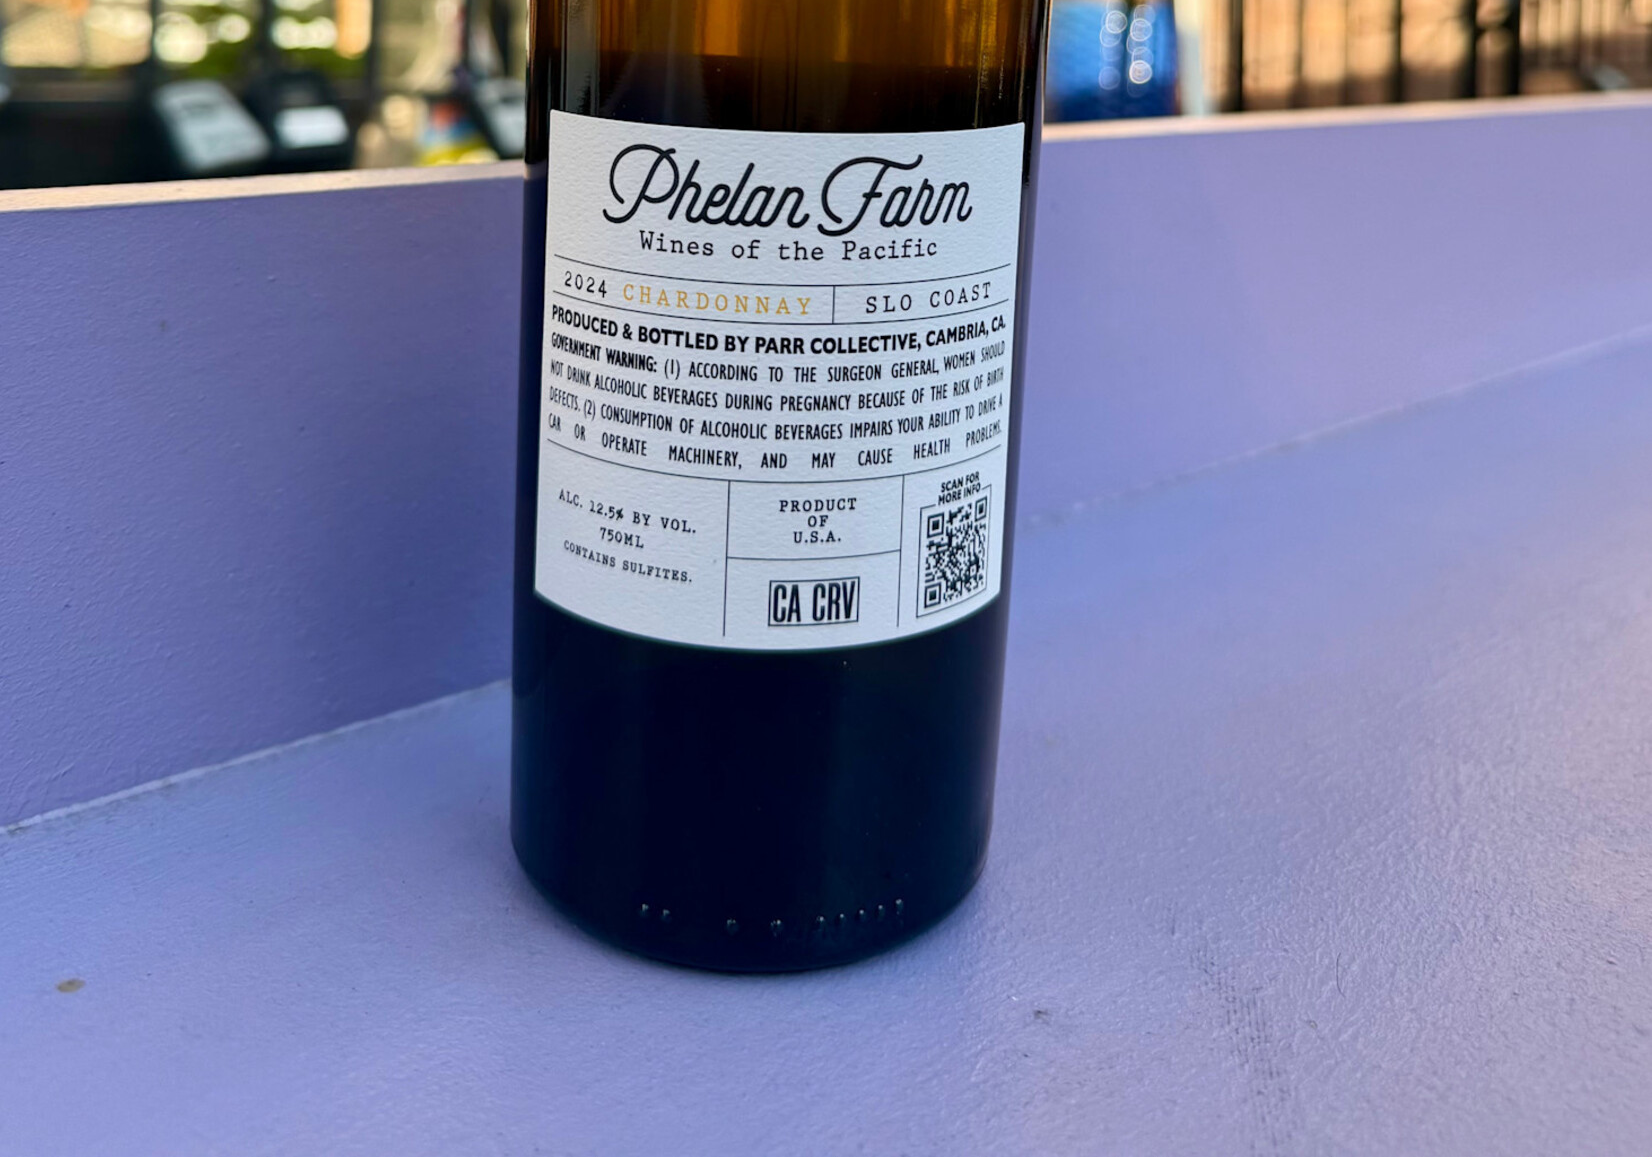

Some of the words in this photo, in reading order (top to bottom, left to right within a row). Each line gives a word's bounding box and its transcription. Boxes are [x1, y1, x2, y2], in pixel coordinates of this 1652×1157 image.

[602, 144, 810, 229] Phelan
[817, 154, 972, 237] Farm
[639, 230, 714, 257] Wines
[731, 241, 760, 259] of
[778, 241, 824, 261] the
[843, 239, 938, 261] Pacific
[564, 271, 607, 297] 2024
[623, 284, 811, 315] CHARDONNAY
[866, 294, 912, 313] SLO
[930, 282, 991, 308] COAST
[552, 304, 618, 336] PRODUCED
[623, 324, 632, 340] &
[638, 326, 718, 350] BOTTLED
[725, 336, 749, 352] BY
[755, 337, 804, 354] PARR
[810, 333, 921, 354] COLLECTIVE,
[926, 321, 988, 347] CAMBRIA,
[992, 315, 1006, 331] CA.
[552, 332, 601, 361] GOVERNMENT
[606, 348, 657, 372] WARNING:
[689, 363, 757, 381] ACCORDING
[769, 367, 783, 382] TO
[794, 367, 816, 382] THE
[827, 365, 881, 382] SURGEON
[892, 358, 939, 378] GENERAL,
[944, 350, 975, 371] WOMEN
[981, 341, 1005, 363] SHOULD
[551, 359, 563, 375] NOT
[567, 367, 591, 386] DRINK
[595, 374, 647, 399] ALCOHOLIC
[654, 386, 717, 408] BEVERAGES
[726, 395, 772, 411] DURING
[781, 395, 850, 411] PREGNANCY
[858, 391, 905, 409] BECAUSE
[912, 388, 924, 404] OF
[931, 384, 947, 401] THE
[953, 379, 970, 396] RISK
[974, 375, 983, 391] OF
[987, 366, 1004, 387] BIRTH
[550, 386, 580, 412] DEFECTS.
[584, 399, 595, 421] (2)
[601, 404, 672, 432] CONSUMPTION
[680, 418, 694, 434] OF
[701, 421, 767, 440] ALCOHOLIC
[775, 424, 842, 440] BEVERAGES
[850, 420, 893, 438] IMPAIRS
[898, 416, 924, 434] YOUR
[928, 408, 960, 429] ABILITY
[965, 404, 974, 420] TO
[978, 397, 996, 416] DRIVE
[549, 413, 561, 432] CAR
[574, 424, 586, 441] OR
[602, 432, 647, 456] OPERATE
[669, 445, 742, 470] MACHINERY,
[761, 453, 787, 468] AND
[812, 453, 835, 468] MAY
[858, 448, 892, 466] CAUSE
[914, 439, 950, 459] HEALTH
[938, 489, 961, 505] MORE
[964, 483, 981, 498] INFO
[941, 480, 964, 493] SCAN
[966, 472, 979, 484] FOR
[559, 489, 583, 508] ALC.
[589, 500, 624, 520] 12.5%
[633, 511, 651, 526] BY
[661, 517, 696, 534] VOL.
[779, 497, 857, 512] PRODUCT
[808, 515, 829, 527] OF
[600, 527, 644, 549] 750ML
[793, 531, 841, 543] U.S.A.
[564, 540, 616, 567] CONTAINS
[623, 560, 692, 583] SULFITES.
[773, 583, 801, 623] CA
[812, 581, 855, 621] CRV
